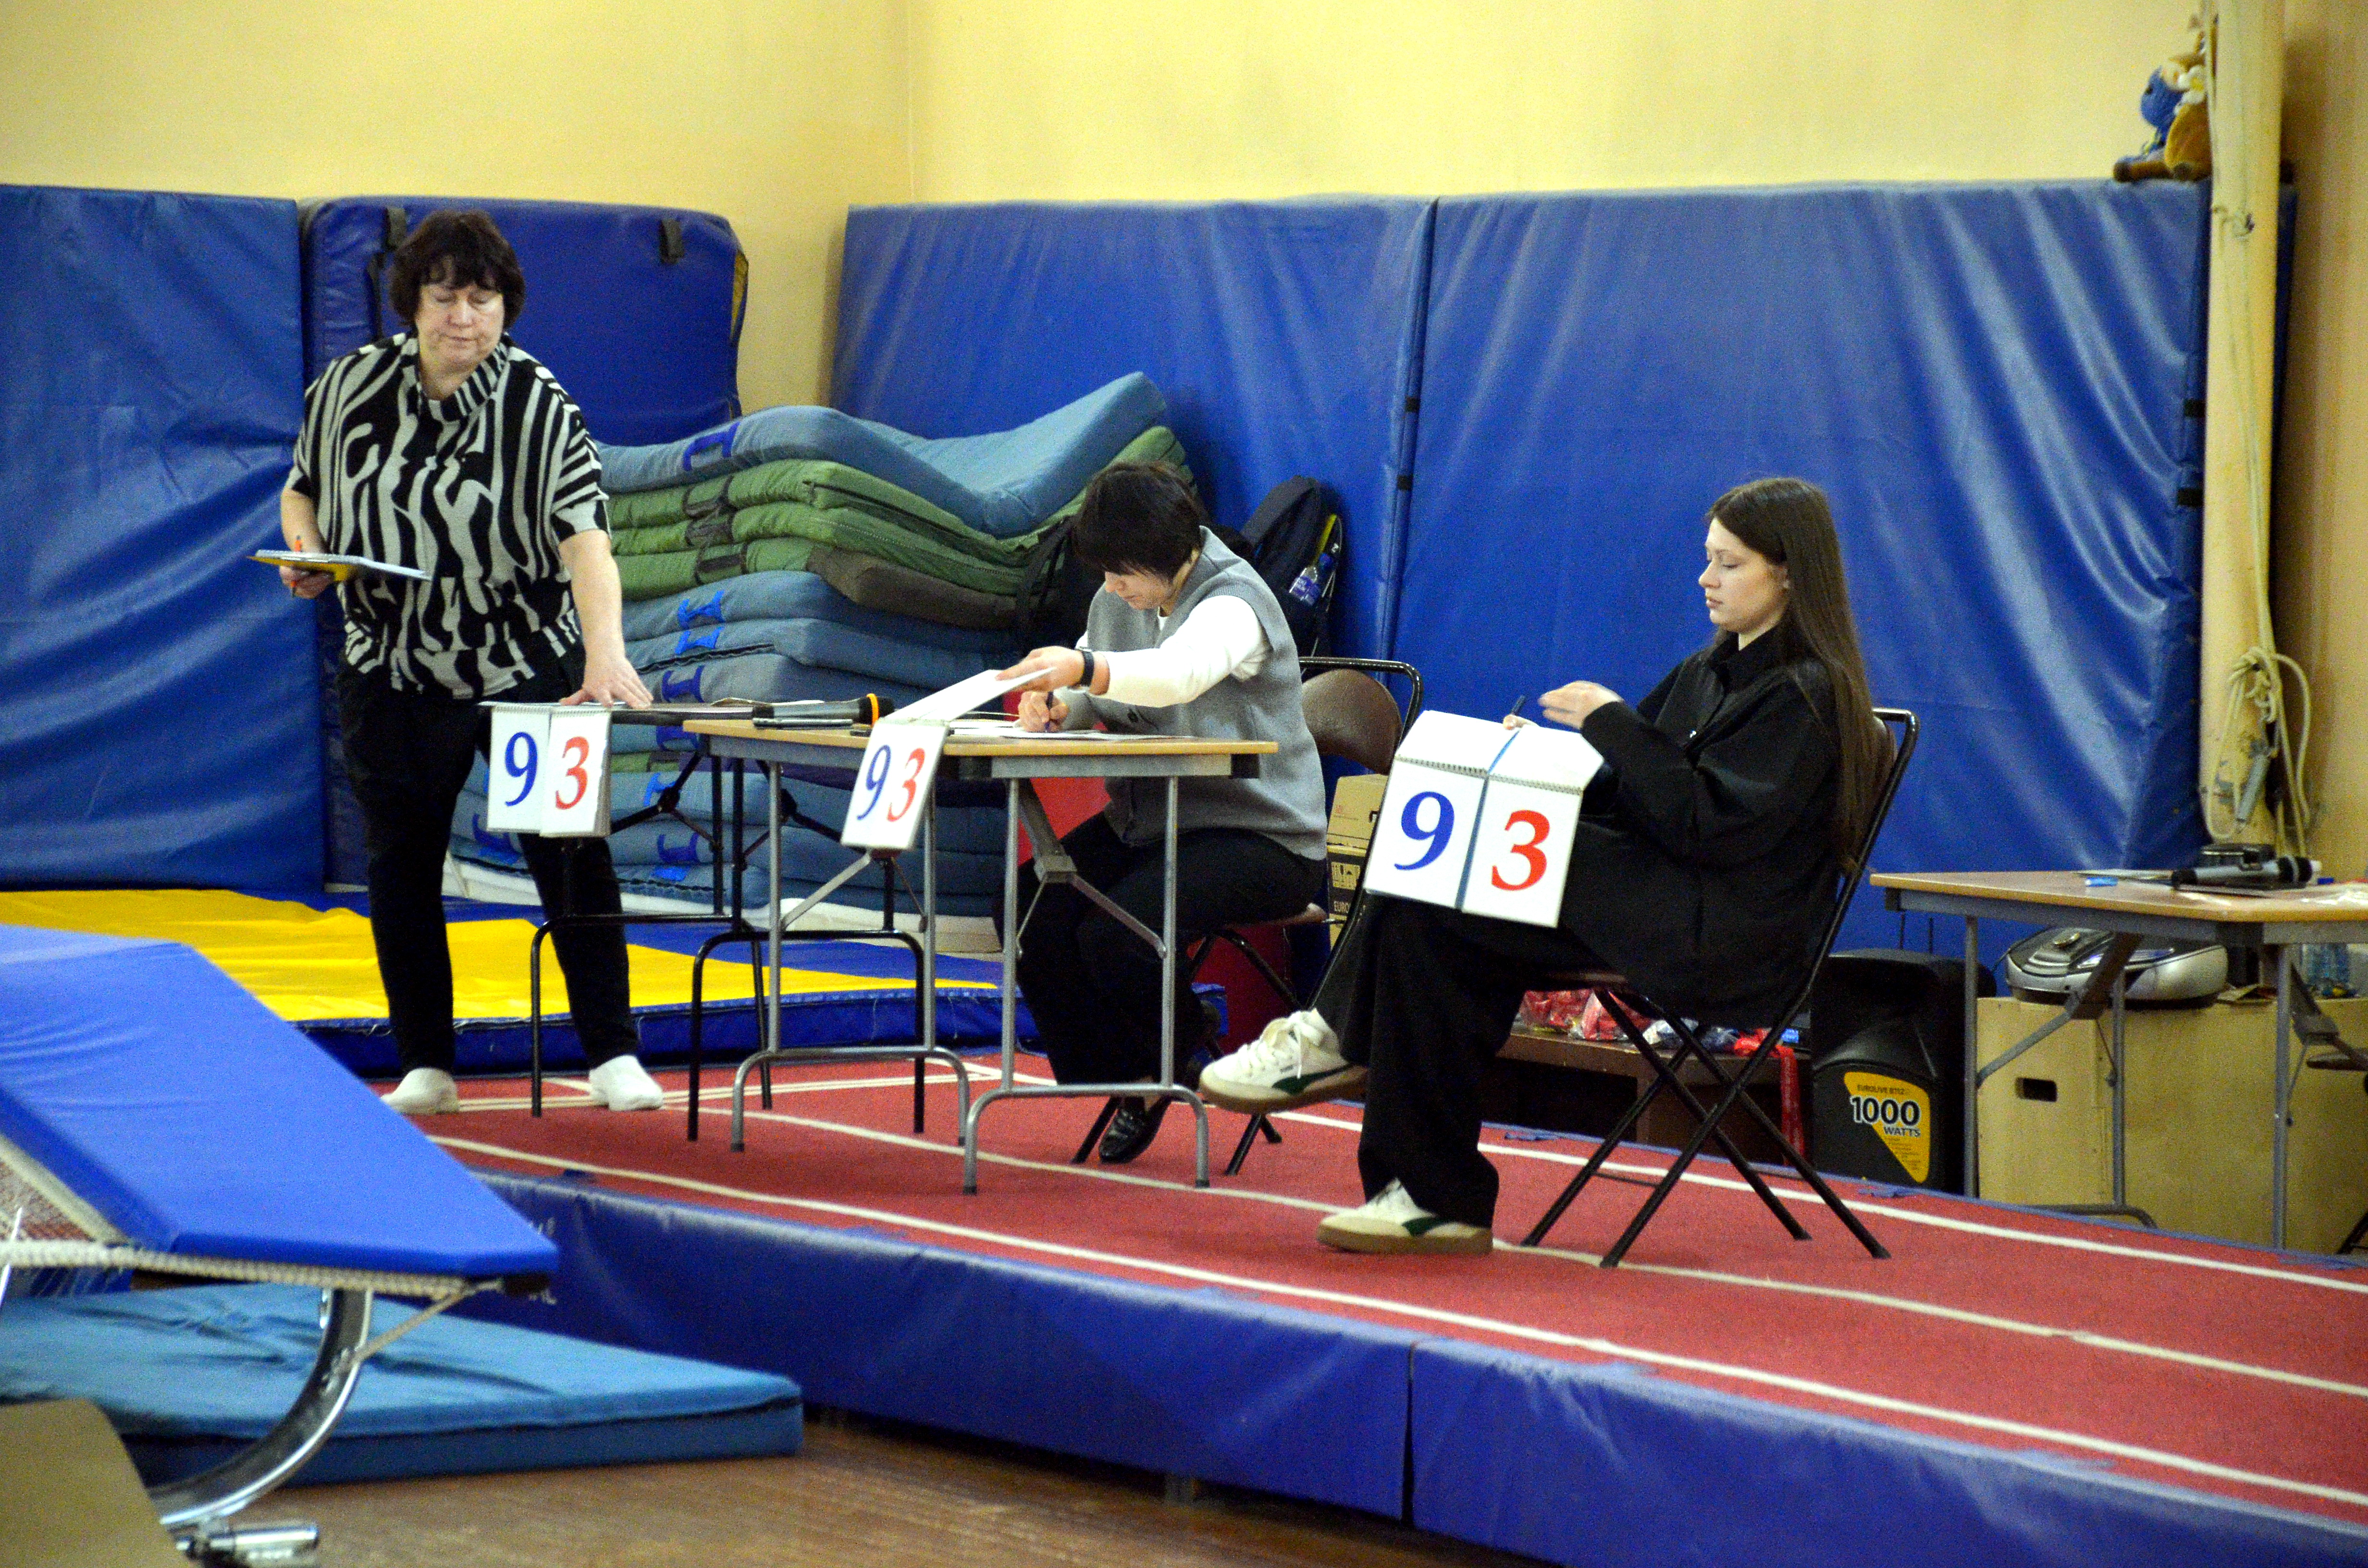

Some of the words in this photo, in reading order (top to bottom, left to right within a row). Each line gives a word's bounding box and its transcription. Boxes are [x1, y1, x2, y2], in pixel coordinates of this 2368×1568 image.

[505, 732, 538, 807] 9
[555, 736, 589, 809] 3
[857, 745, 891, 821] 9
[887, 747, 925, 822] 3
[1394, 791, 1455, 870] 9
[1491, 809, 1550, 891] 3
[1334, 901, 1350, 913] EURO
[1850, 1096, 1921, 1127] 1000
[1884, 1127, 1921, 1137] WATTS
